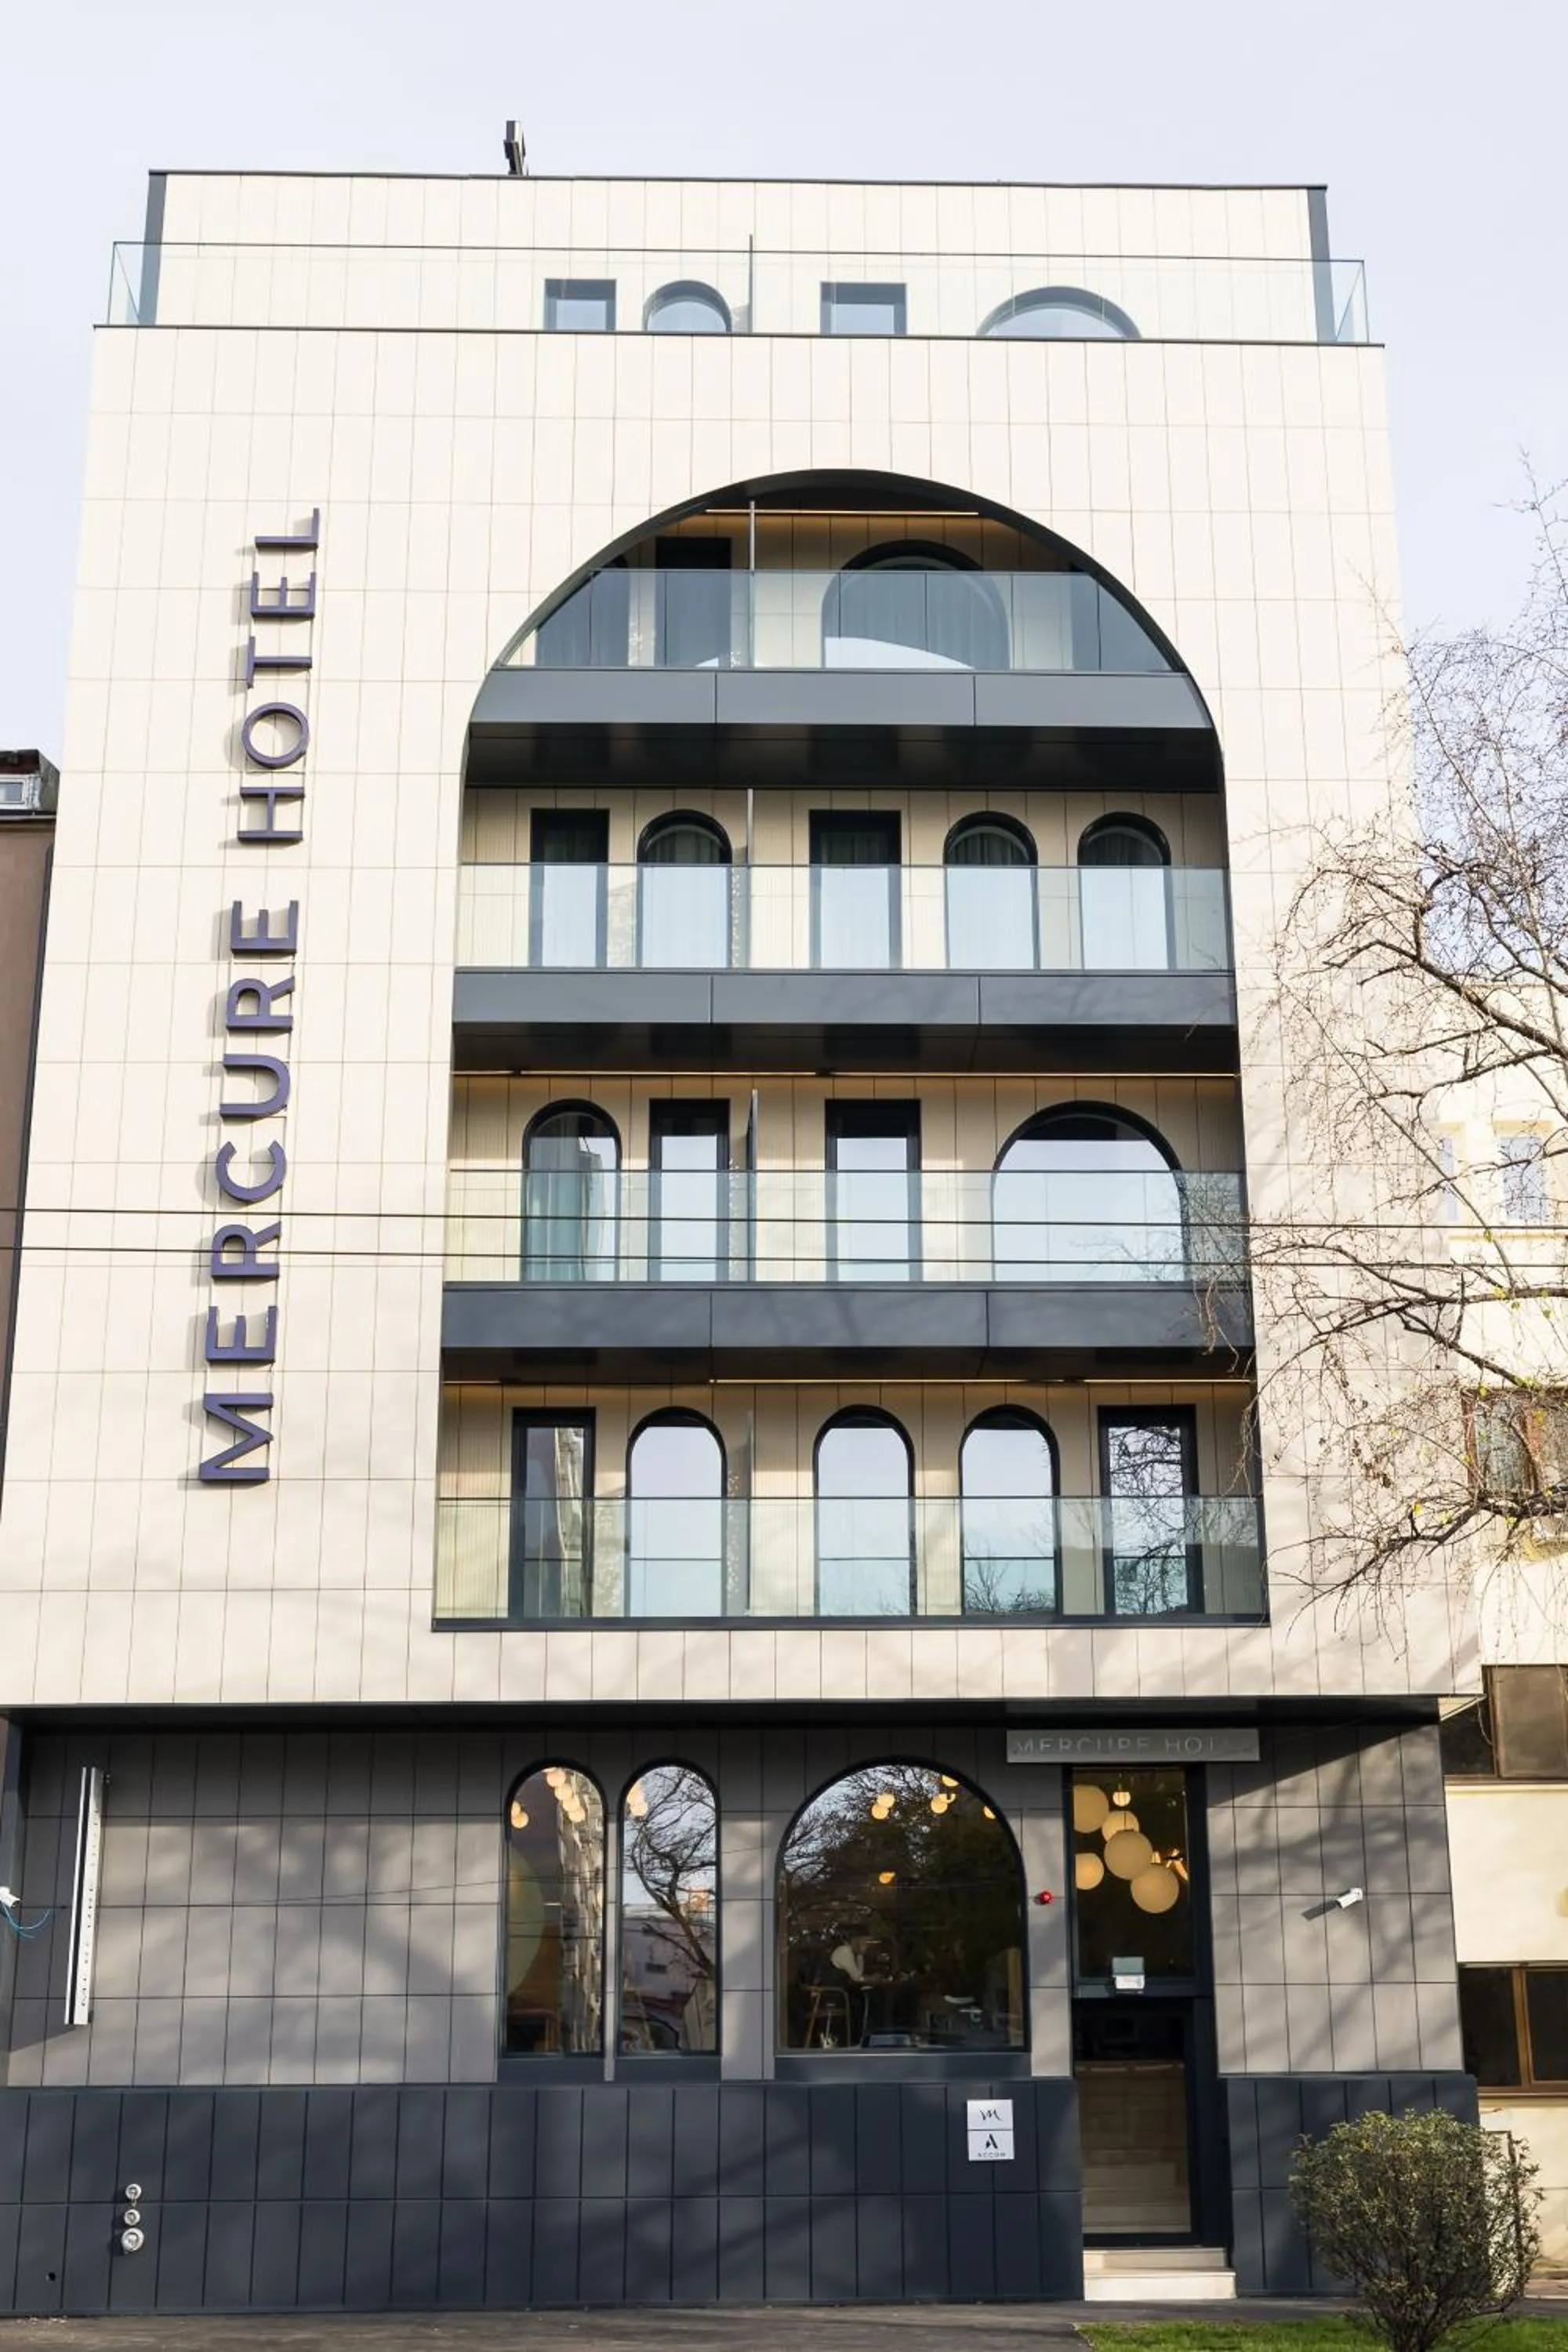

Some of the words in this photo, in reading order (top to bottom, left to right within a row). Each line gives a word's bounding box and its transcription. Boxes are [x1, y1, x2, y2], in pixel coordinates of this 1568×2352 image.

[237, 507, 320, 842] HOTEL
[198, 900, 300, 1483] MERCURE
[1017, 1737, 1150, 1754] MERCURE
